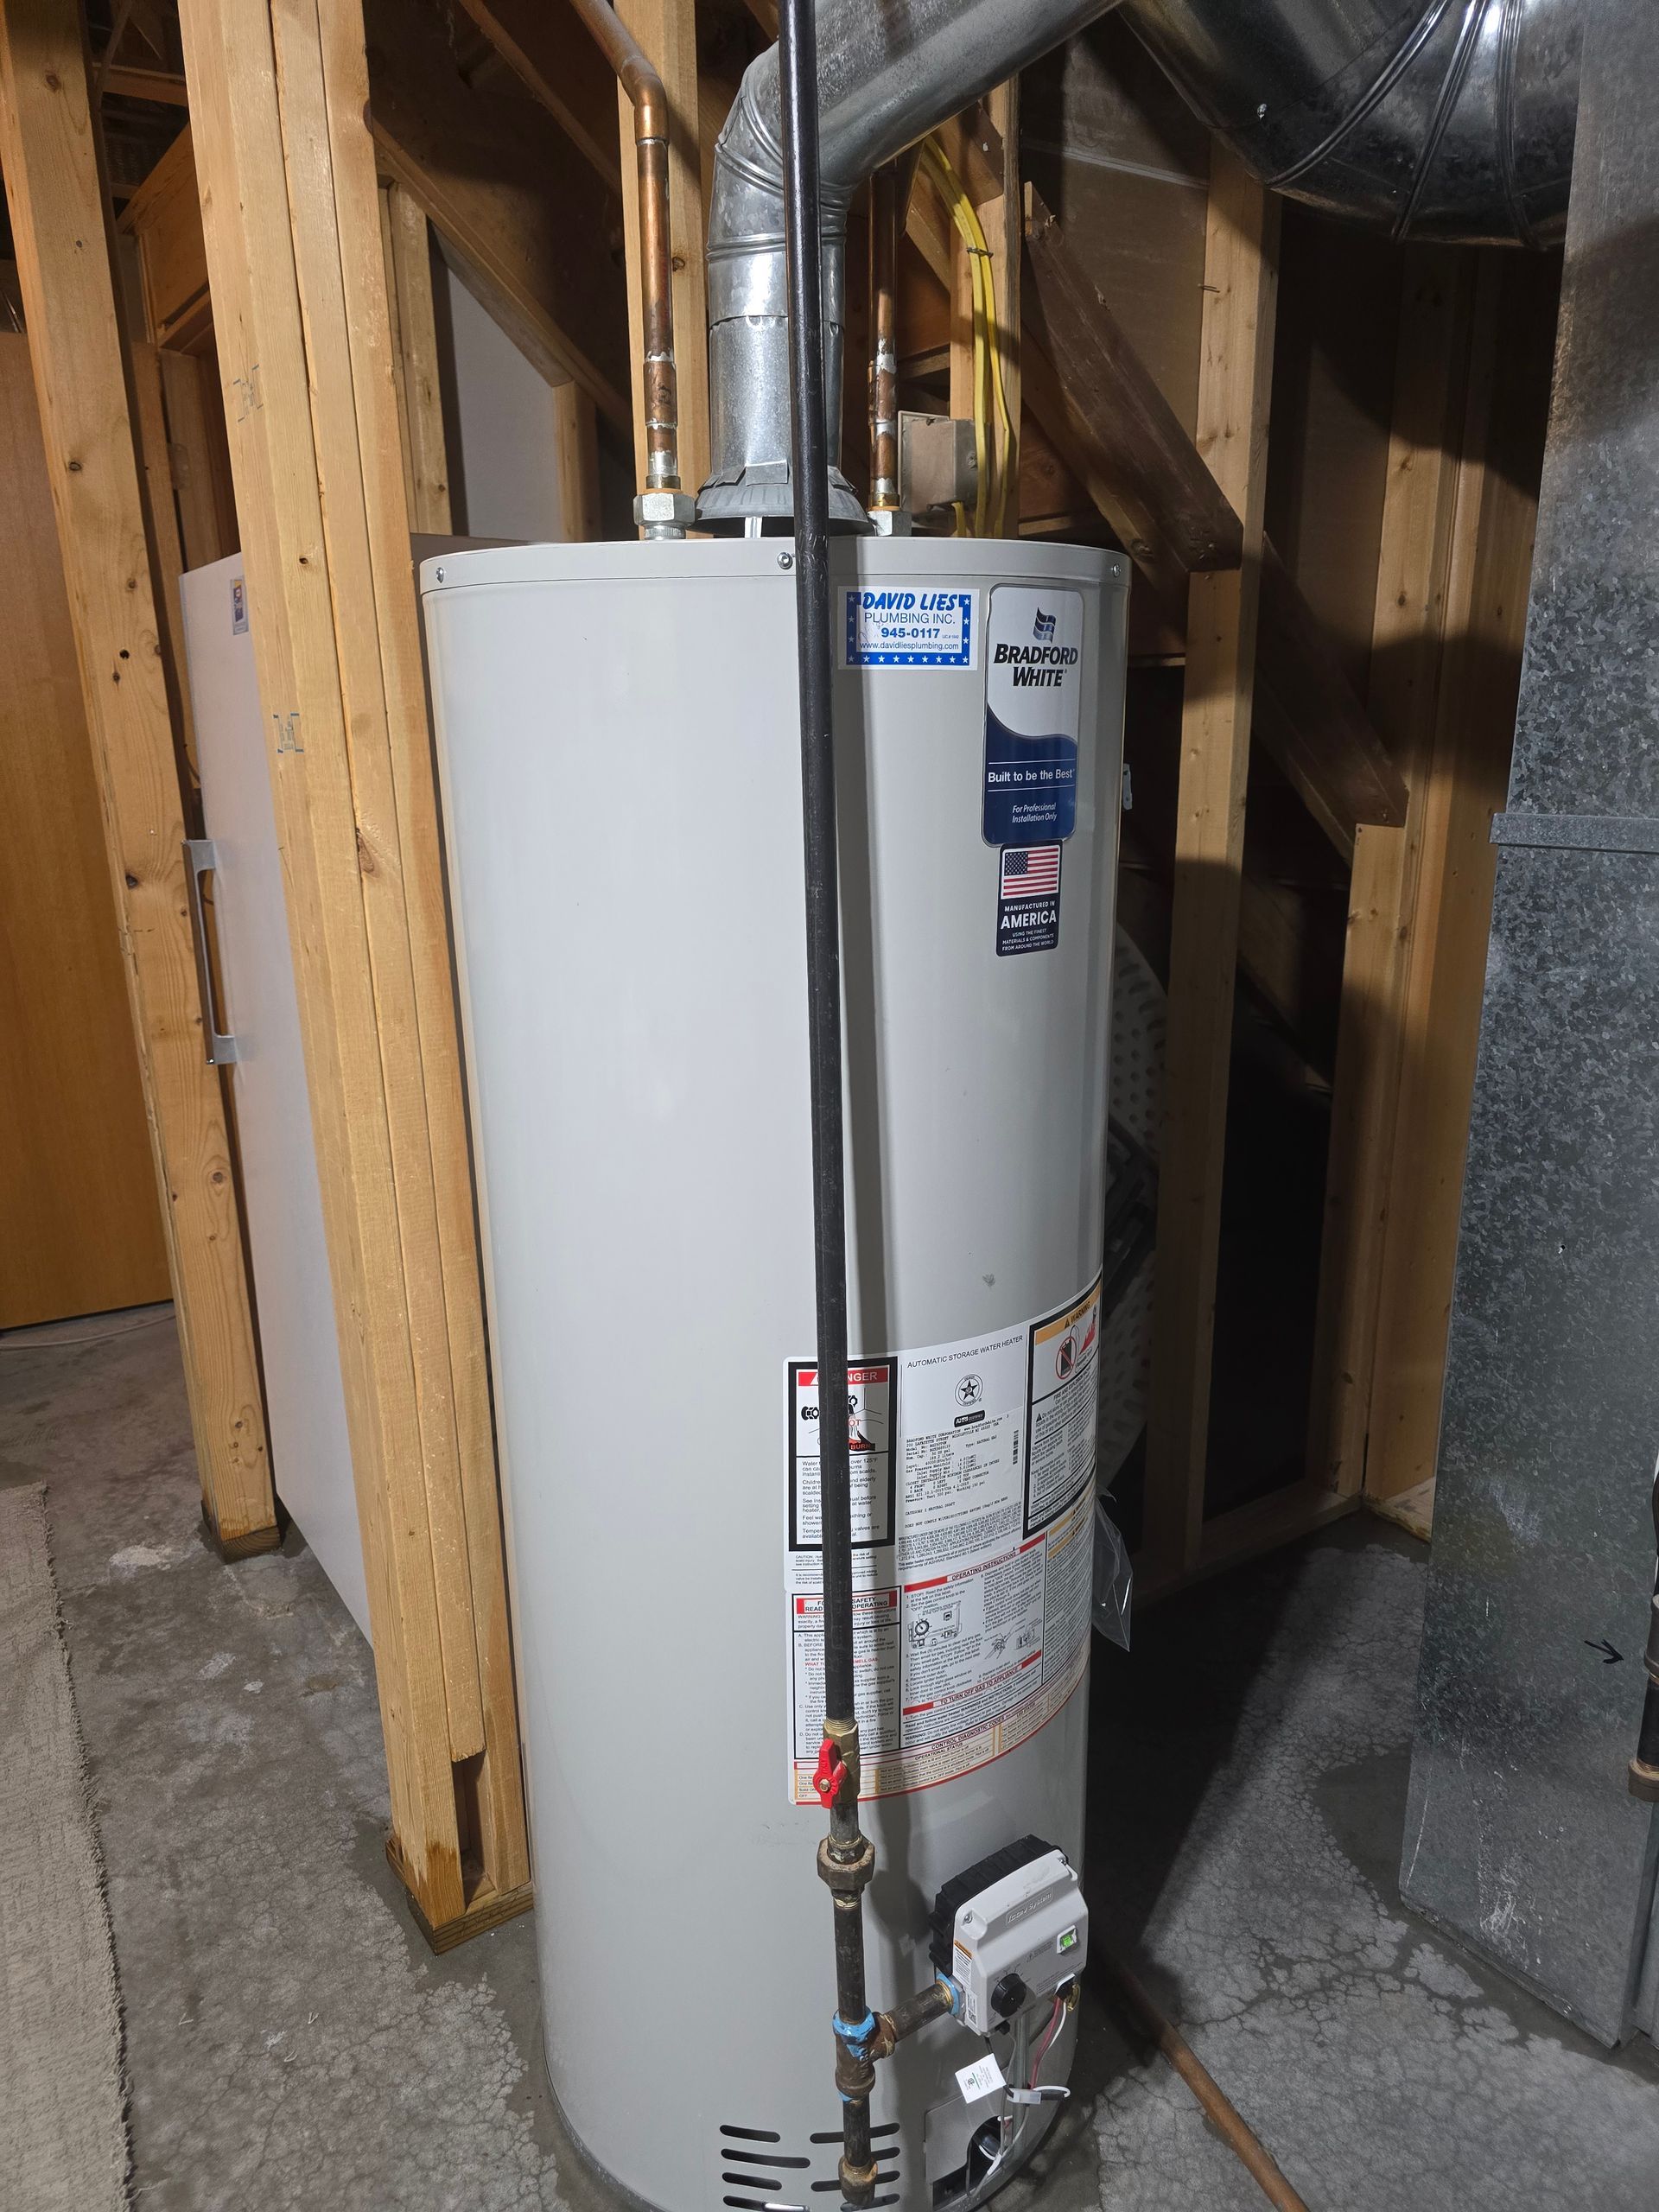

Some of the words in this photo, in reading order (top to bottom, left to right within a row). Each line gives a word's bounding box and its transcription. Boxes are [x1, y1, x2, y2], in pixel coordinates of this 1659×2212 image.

[863, 592, 915, 610] DAVID
[920, 594, 957, 611] LIES
[865, 613, 929, 624] PLUMBING
[933, 613, 955, 624] INC.
[881, 627, 940, 639] 945-0117
[860, 642, 959, 651] www.davidliesplumbing.com
[994, 644, 1078, 664] BRADFORD
[1013, 666, 1064, 686] WHITE
[988, 772, 1010, 783] Built
[1014, 772, 1022, 781] to
[1026, 771, 1037, 781] be
[1040, 770, 1053, 779] the
[1056, 769, 1072, 779] Best
[1023, 803, 1056, 812] Professional
[1012, 814, 1044, 823] Installation
[1046, 812, 1057, 821] Only
[1005, 902, 1048, 912] MANUFACTURED
[1001, 910, 1057, 930] AMERICA
[907, 1357, 947, 1368] AUTOMATIC
[949, 1349, 978, 1361] STORAGE
[980, 1342, 1001, 1353] WATER
[1002, 1335, 1023, 1347] HEATER
[848, 1371, 878, 1382] NGER
[952, 1567, 982, 1580] OPERATING
[982, 1552, 1016, 1572] INSTRUCTIONS
[950, 1694, 963, 1703] TURN
[964, 1689, 974, 1698] OFF
[975, 1685, 985, 1694] GAS
[994, 1667, 1019, 1684] APPLIANCE
[931, 1738, 957, 1750] CONTROL
[958, 1724, 988, 1741] DIAGNOSTIC
[915, 1749, 946, 1760] OPERATIONAL
[947, 1742, 963, 1752] STATUS
